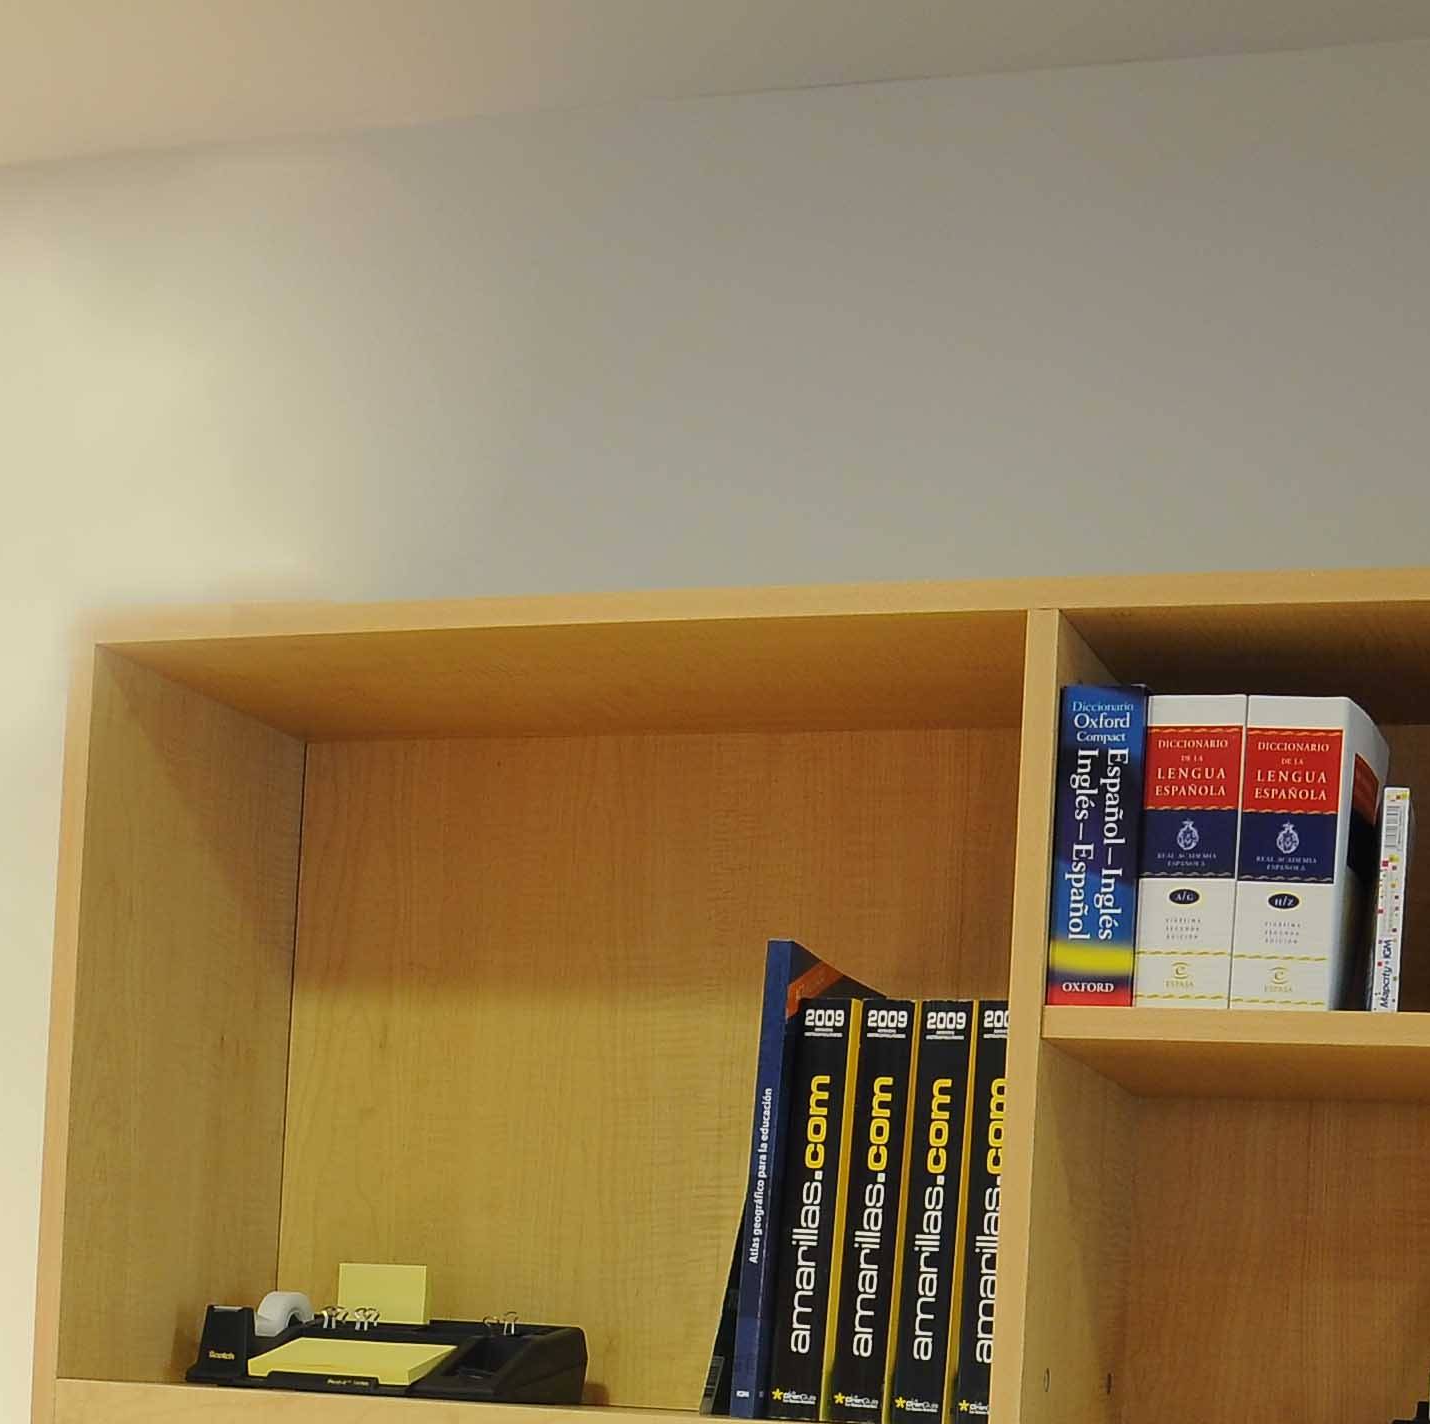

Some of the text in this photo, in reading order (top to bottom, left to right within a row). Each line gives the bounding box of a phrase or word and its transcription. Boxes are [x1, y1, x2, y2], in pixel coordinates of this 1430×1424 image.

[1072, 701, 1133, 712] Diccionario
[1074, 712, 1130, 729] Oxford
[1076, 731, 1126, 744] Compact
[1158, 739, 1228, 749] DICCIONARIO
[1258, 741, 1330, 752] DICCIONARIO
[1157, 767, 1226, 780] LENGUA
[1257, 769, 1327, 783] LENGUA
[1155, 783, 1226, 796] ESPAÑOLA
[1255, 787, 1327, 801] ESPAÑOLA
[1062, 981, 1115, 994] OXFORD
[805, 1009, 845, 1027] 2009
[867, 1010, 908, 1028] 2009
[926, 1012, 967, 1030] 2009
[983, 1010, 1008, 1028] 200
[748, 1087, 773, 1264] Atlas geográfico para la educación
[791, 1074, 831, 1355] amarillas.com
[852, 1075, 894, 1358] amarillas.com
[912, 1078, 953, 1362] amarillas.com
[208, 1350, 235, 1360] Scotch
